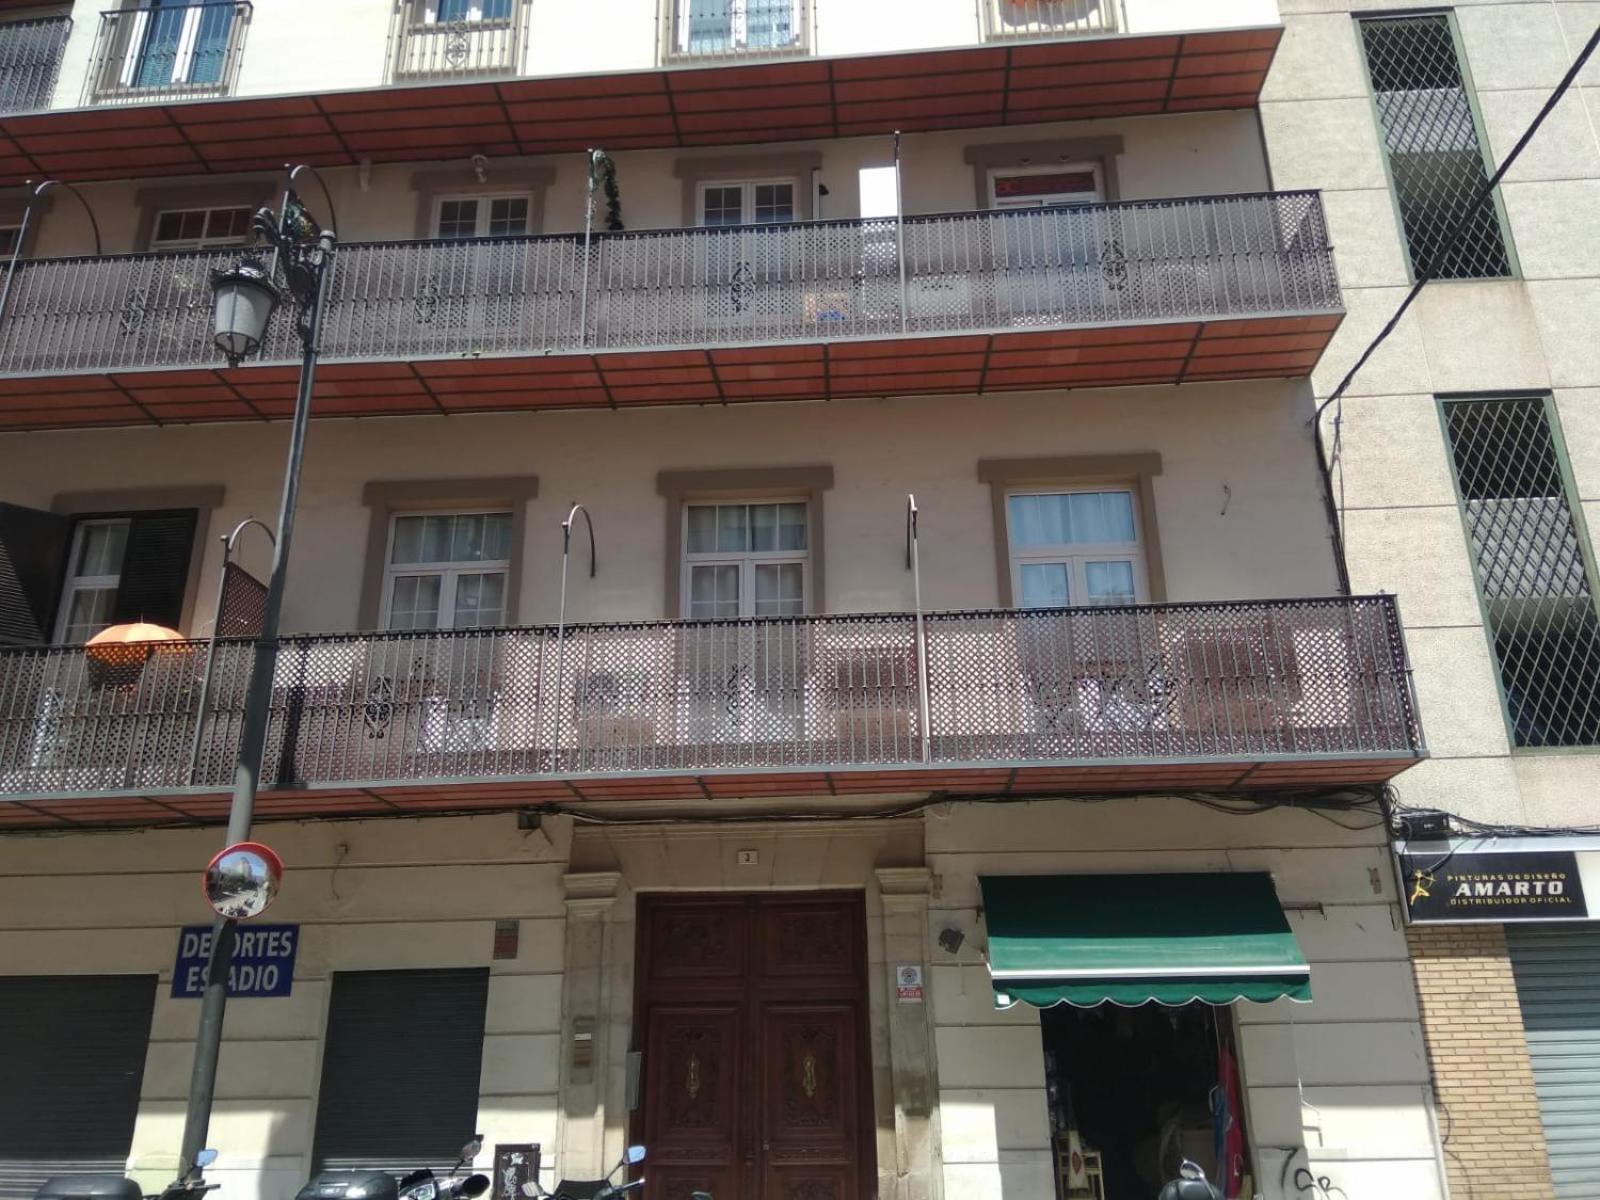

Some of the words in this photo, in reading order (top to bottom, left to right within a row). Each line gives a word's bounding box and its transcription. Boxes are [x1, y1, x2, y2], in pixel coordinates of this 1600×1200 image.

[1447, 874, 1504, 882] PINTURAS
[1507, 873, 1520, 881] DE
[1455, 881, 1563, 897] AMARTO
[1450, 898, 1527, 906] DISTRIBUIDOR
[1530, 897, 1572, 905] OFICIAL
[182, 932, 292, 958] DERTES
[186, 965, 278, 991] ESADIO
